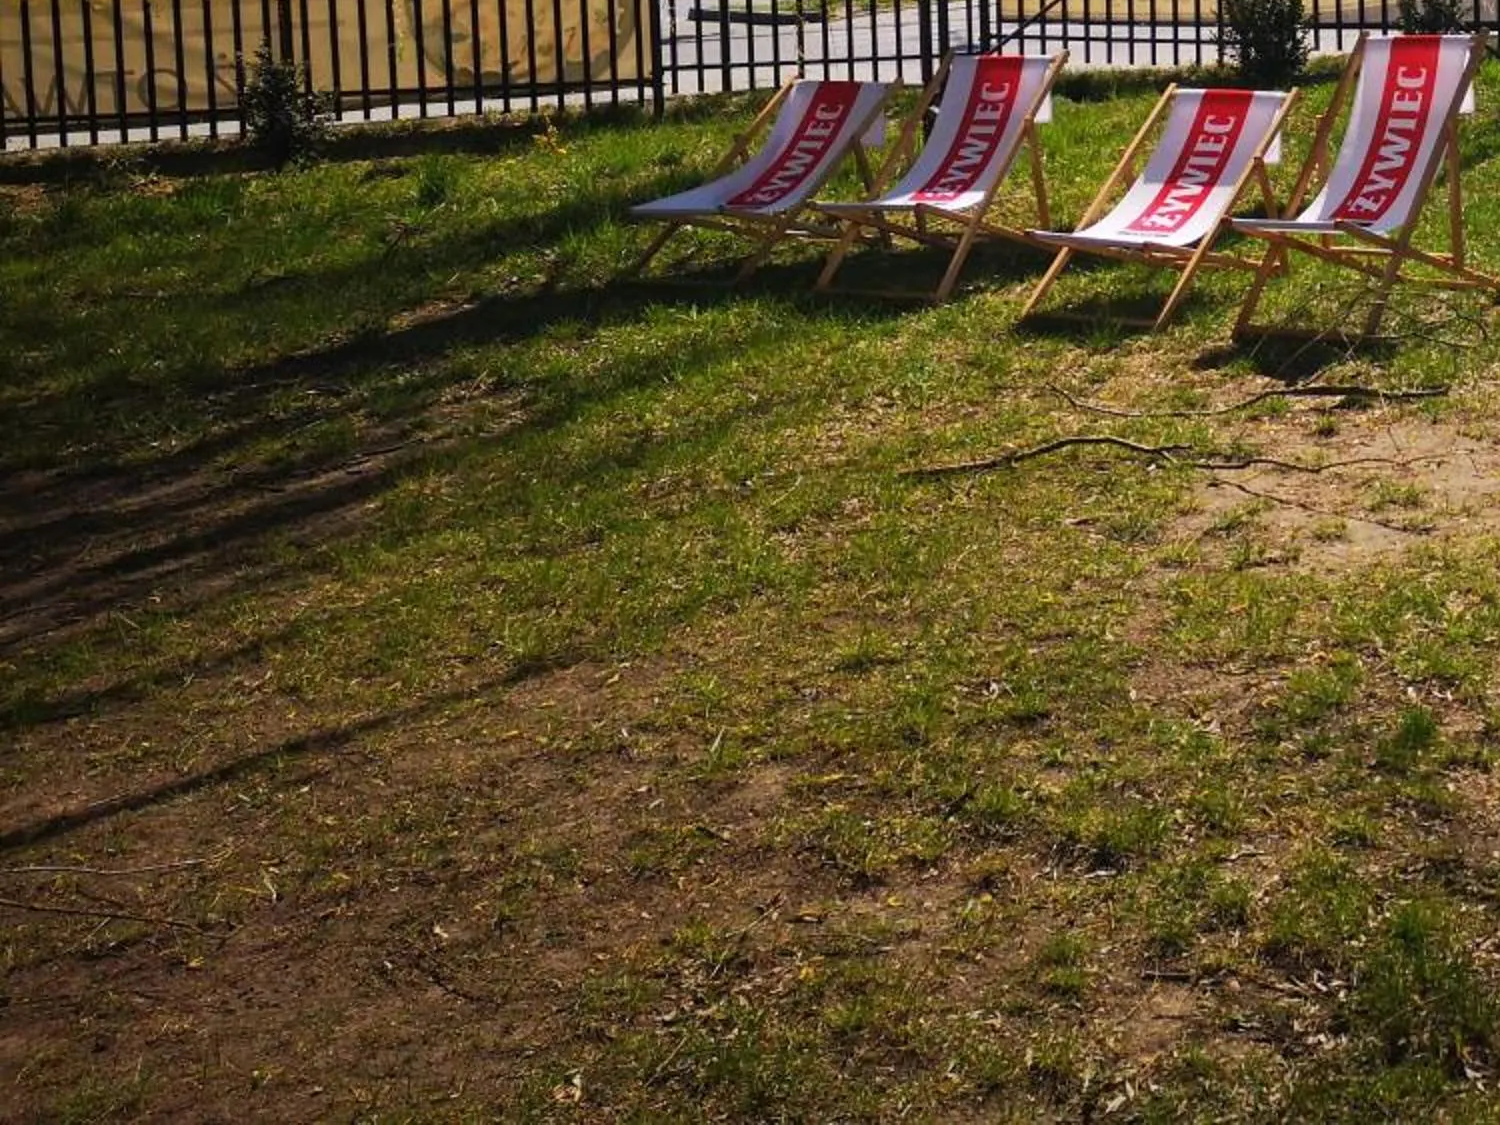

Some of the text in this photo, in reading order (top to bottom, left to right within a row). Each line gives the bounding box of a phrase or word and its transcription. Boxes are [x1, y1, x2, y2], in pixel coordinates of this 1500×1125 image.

[746, 103, 845, 203] ŻYWIEC
[1141, 115, 1235, 227] ŻYWIEC
[1347, 66, 1427, 213] ŻYWIEC
